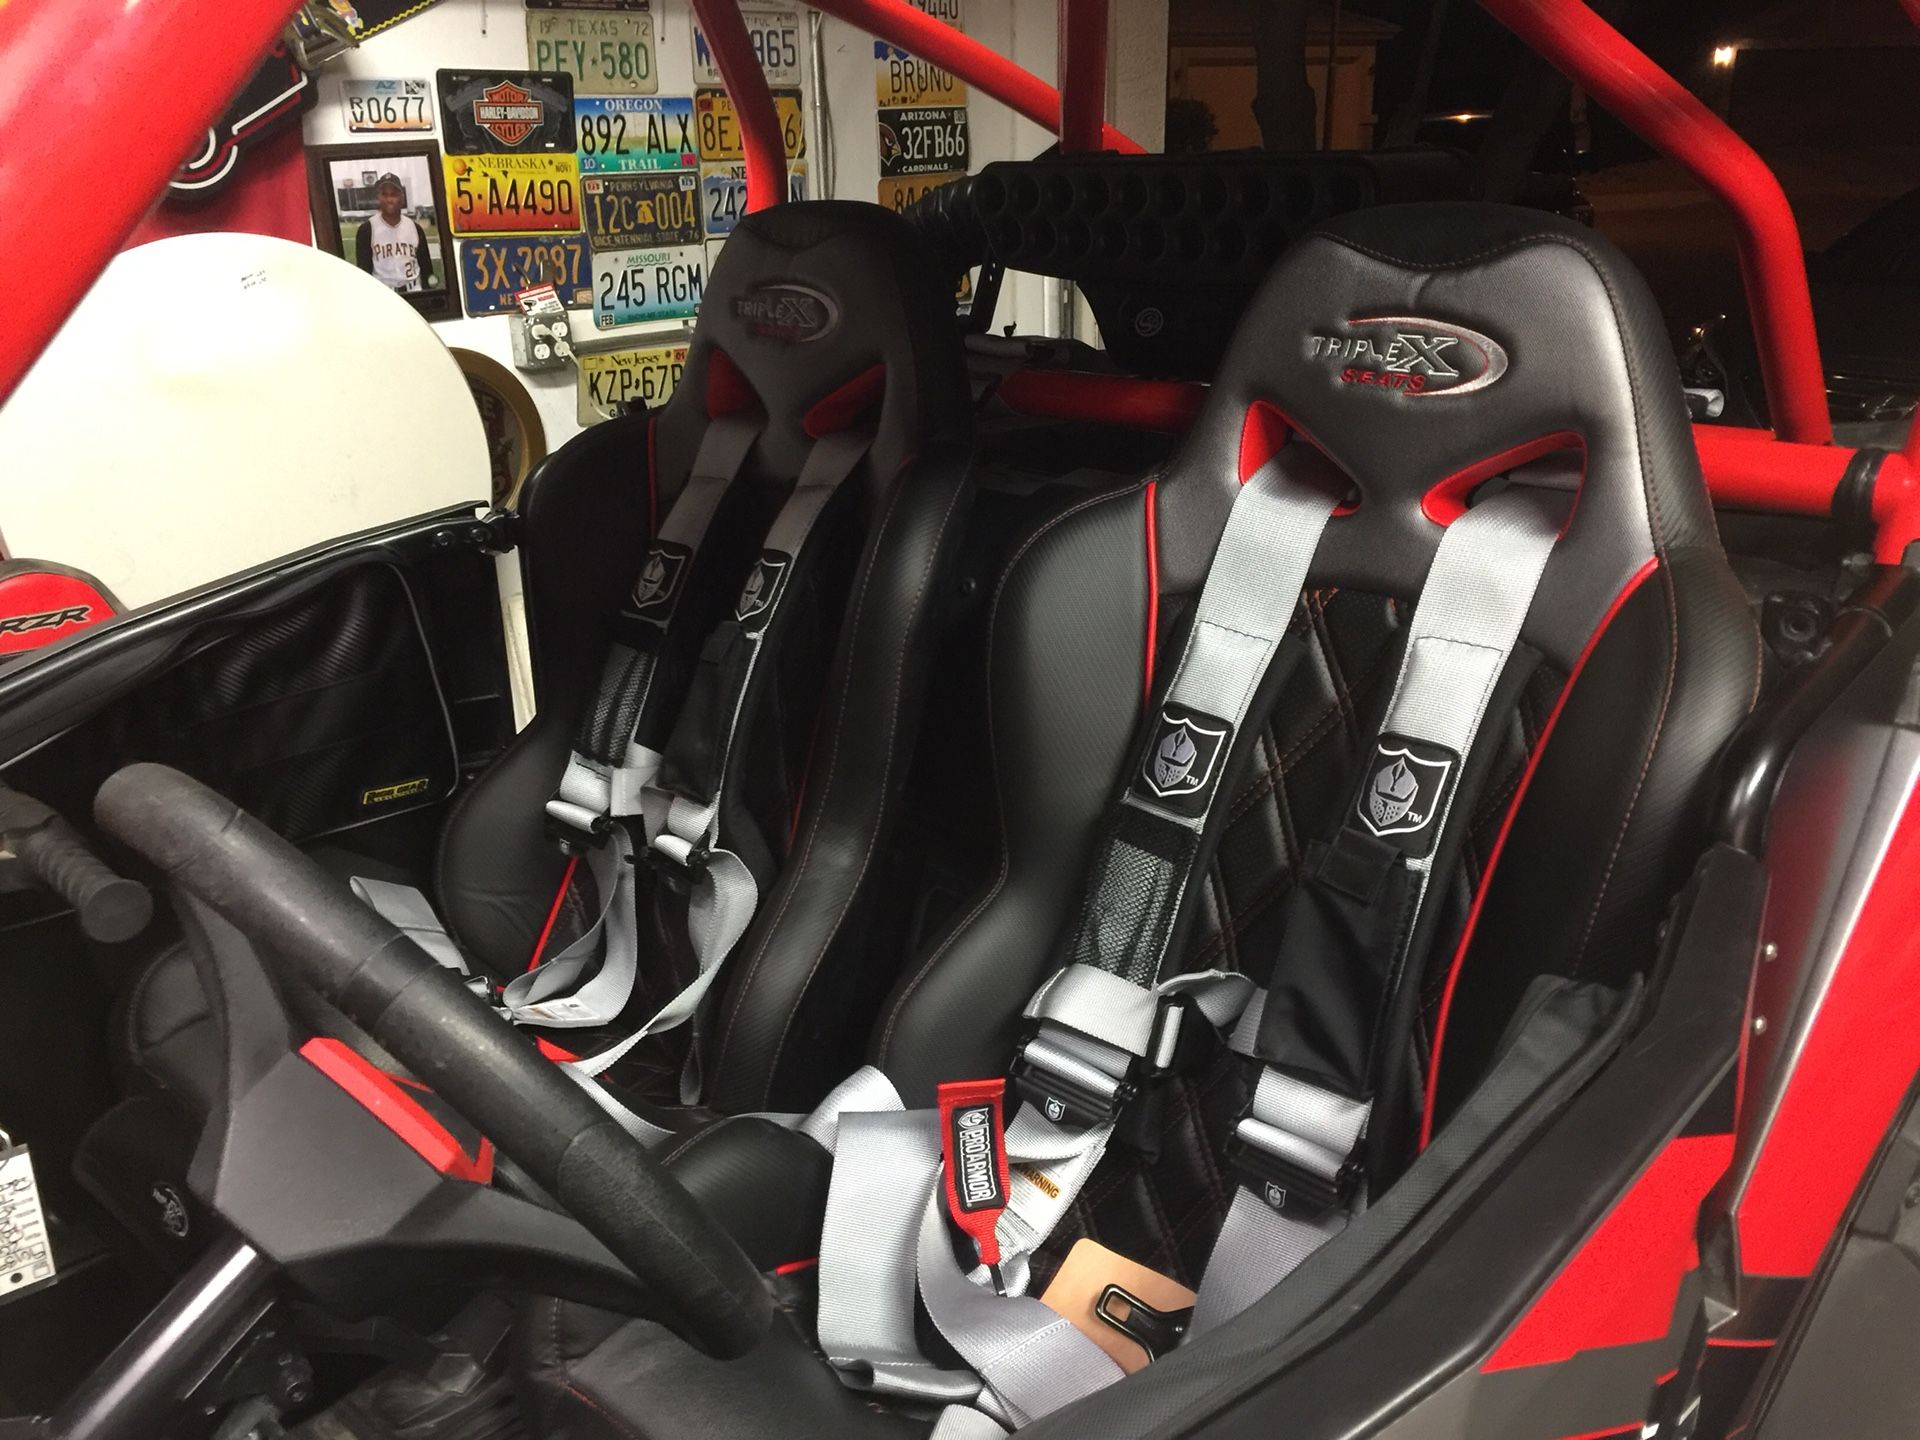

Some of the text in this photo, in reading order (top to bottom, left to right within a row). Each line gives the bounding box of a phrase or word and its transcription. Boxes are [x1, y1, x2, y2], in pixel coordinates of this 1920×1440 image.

[567, 19, 619, 36] TEXAS
[632, 20, 649, 36] 72
[600, 41, 650, 81] 580
[604, 98, 663, 112] OREGON
[900, 111, 947, 122] ARIZONA
[580, 113, 694, 156] 892 ALX
[901, 124, 966, 160] 32FB66
[478, 157, 546, 170] NEBRASKA
[619, 158, 662, 171] TRAIL
[901, 163, 949, 174] CARDINALS
[627, 252, 673, 265] MISSOURI
[600, 268, 646, 311] 245
[655, 263, 703, 305] RGM
[601, 314, 614, 327] FEB
[611, 352, 661, 368] New Jersey
[1340, 367, 1427, 391] SEATS
[0, 606, 91, 633] RZR
[1186, 774, 1200, 786] TM
[1407, 810, 1423, 824] TM
